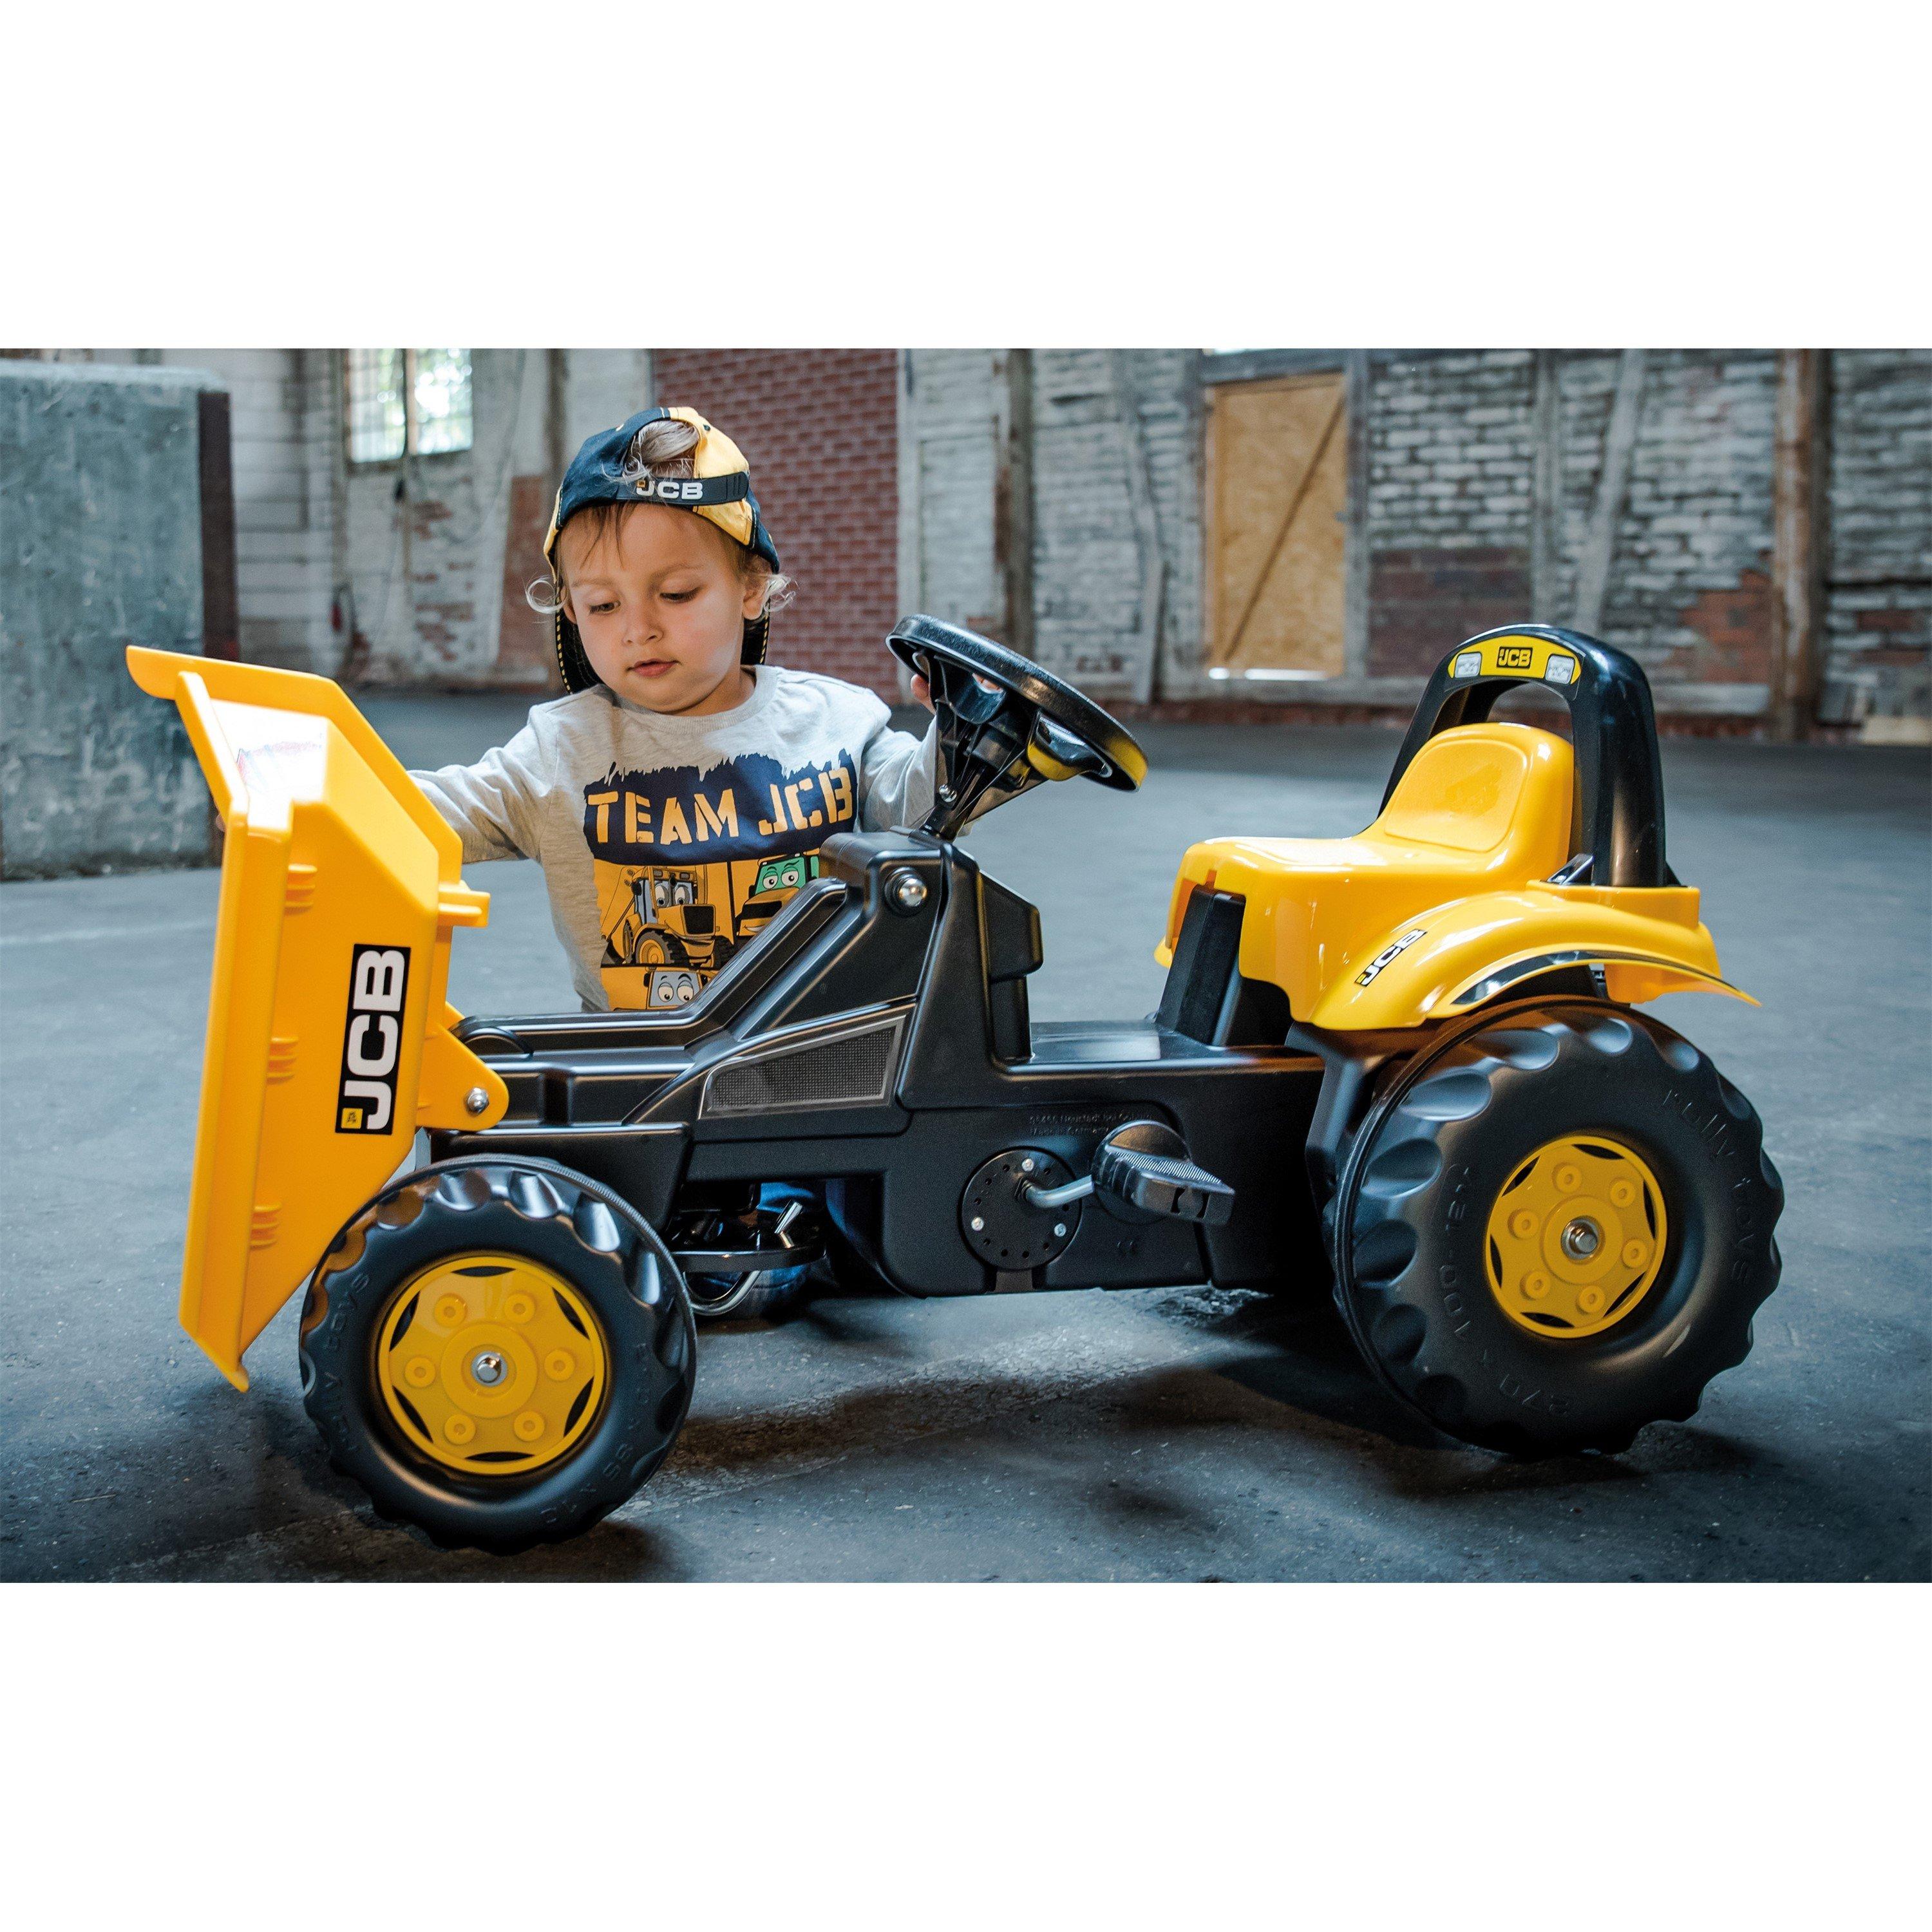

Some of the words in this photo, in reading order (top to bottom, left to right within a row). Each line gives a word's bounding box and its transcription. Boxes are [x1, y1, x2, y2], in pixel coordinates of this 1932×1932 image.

[636, 480, 703, 500] JCB
[1498, 648, 1531, 667] JCB
[587, 788, 740, 846] TEAM
[759, 768, 853, 836] JCB
[1360, 929, 1426, 986] JCB
[343, 950, 405, 1130] JCB
